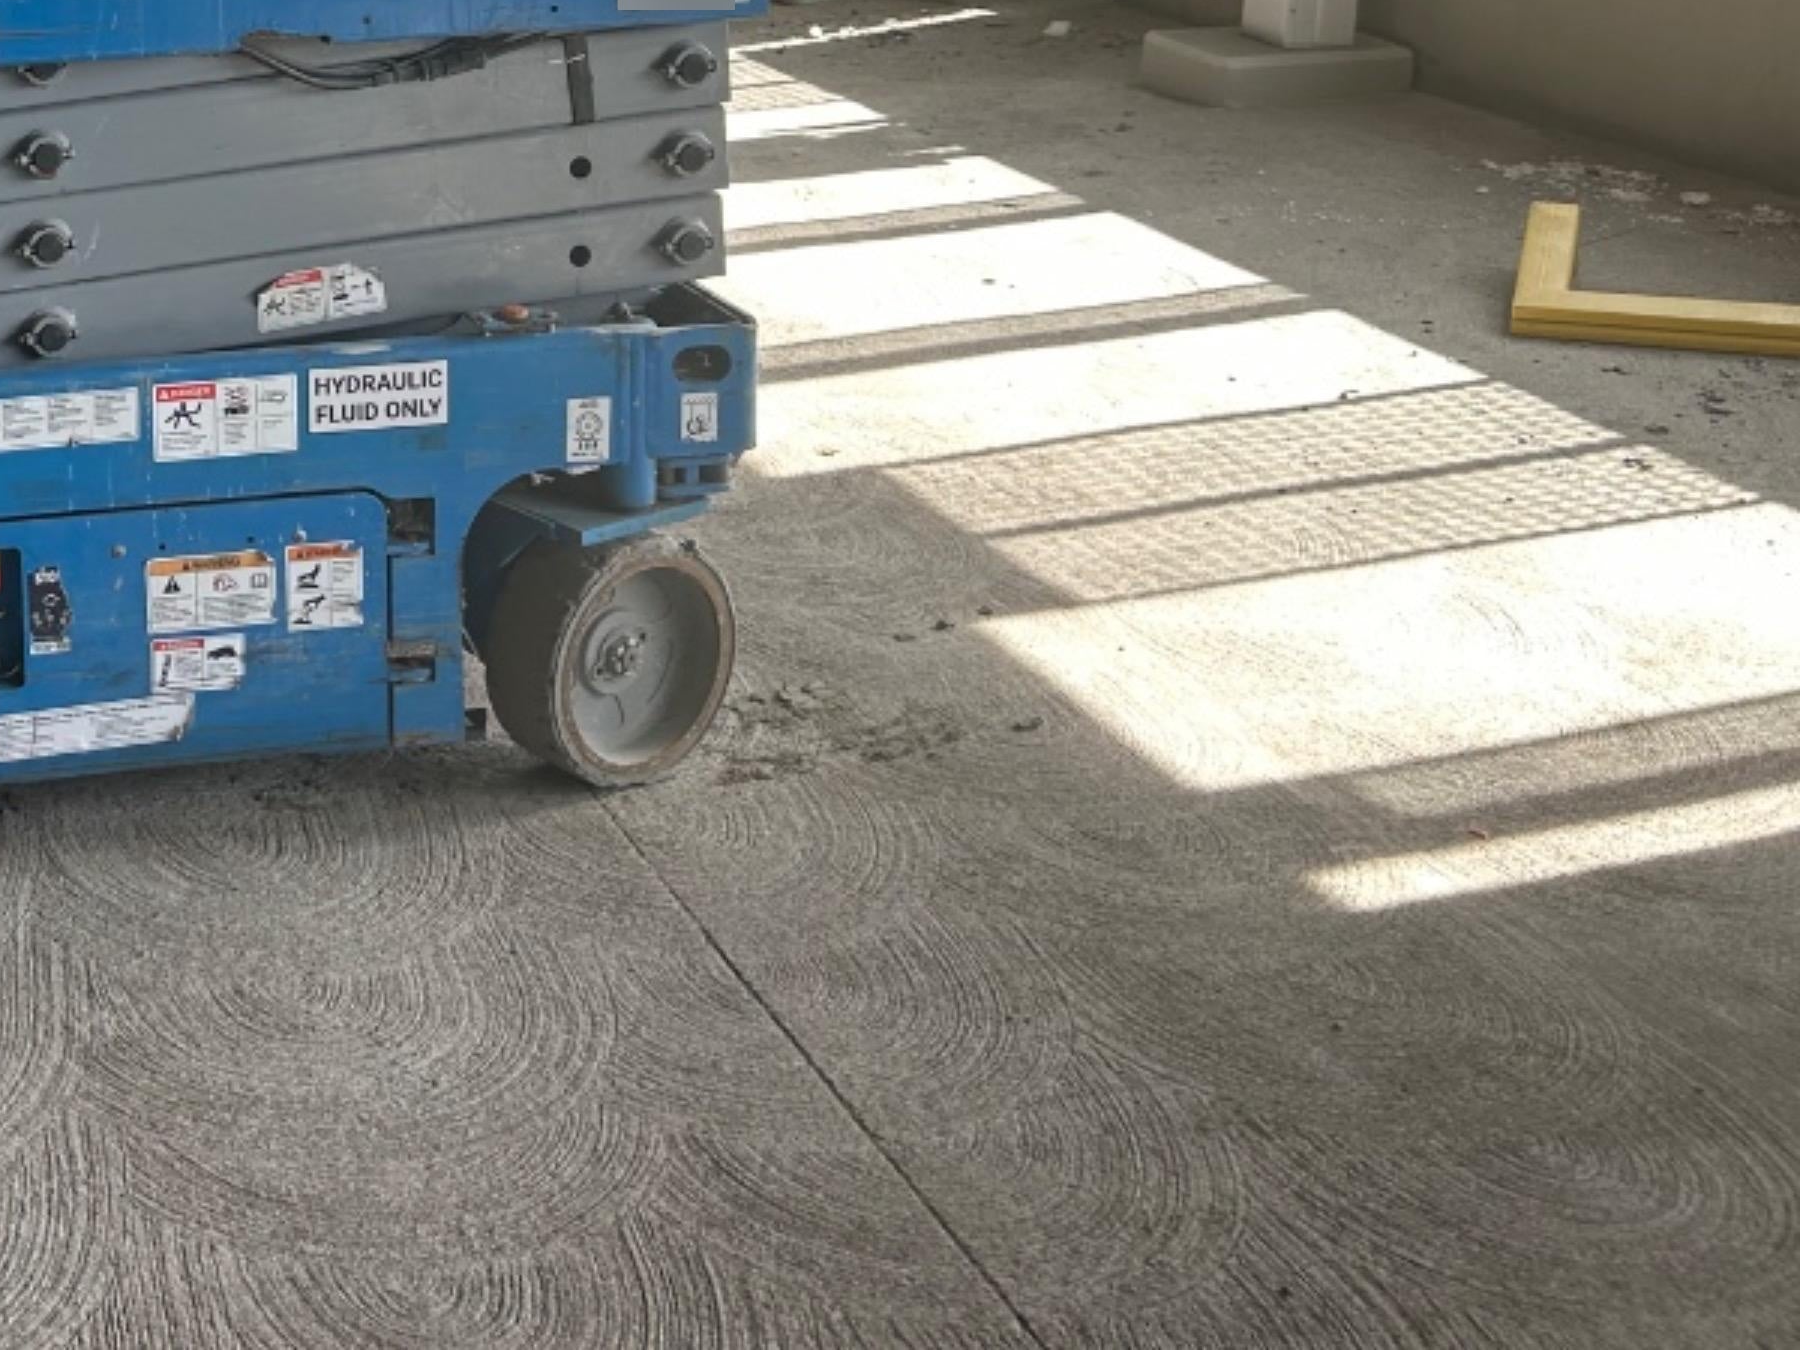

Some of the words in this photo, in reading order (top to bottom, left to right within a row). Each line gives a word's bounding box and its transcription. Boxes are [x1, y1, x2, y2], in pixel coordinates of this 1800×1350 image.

[314, 368, 443, 396] HYDRAULIC
[316, 402, 379, 425] FLUID
[386, 397, 443, 421] ONLY
